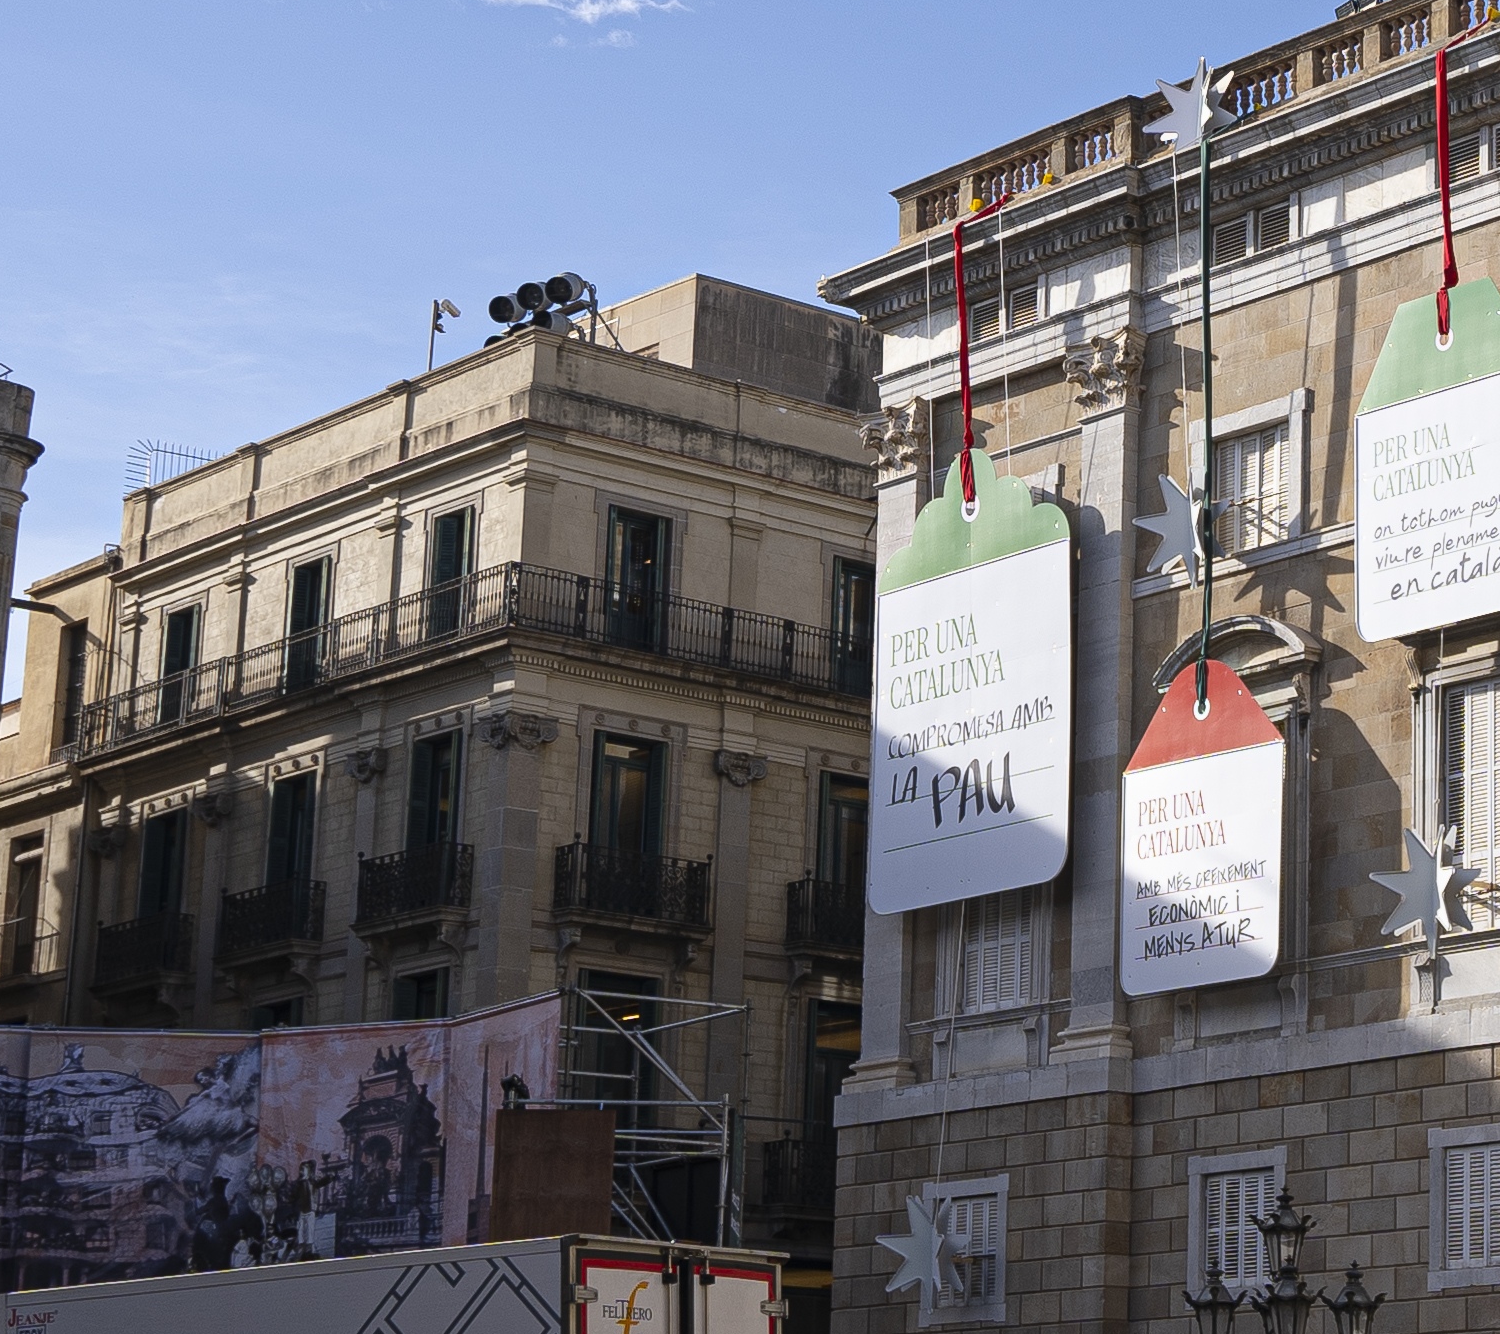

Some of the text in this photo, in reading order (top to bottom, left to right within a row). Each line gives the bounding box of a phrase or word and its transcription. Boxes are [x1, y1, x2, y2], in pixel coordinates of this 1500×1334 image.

[1373, 422, 1451, 468] PER UNA
[1373, 450, 1476, 502] CATALUNYA
[1374, 522, 1395, 540] on
[1401, 504, 1465, 533] tothom
[1375, 547, 1424, 569] viure
[1390, 578, 1424, 600] en
[890, 612, 979, 668] PER UNA
[889, 648, 1006, 710] CATALUNYA
[888, 695, 1054, 760] COMPROMESA AMB
[891, 750, 1016, 829] LA PAU
[1138, 789, 1206, 827] PER UNA
[1137, 819, 1226, 860] CATALUNYA
[1136, 858, 1267, 900] AMB MÉS CREIXEMENT
[1148, 895, 1228, 927] ECONÒMIC
[1144, 917, 1255, 962] MENYS ATUR
[602, 1299, 653, 1321] FELTRERO
